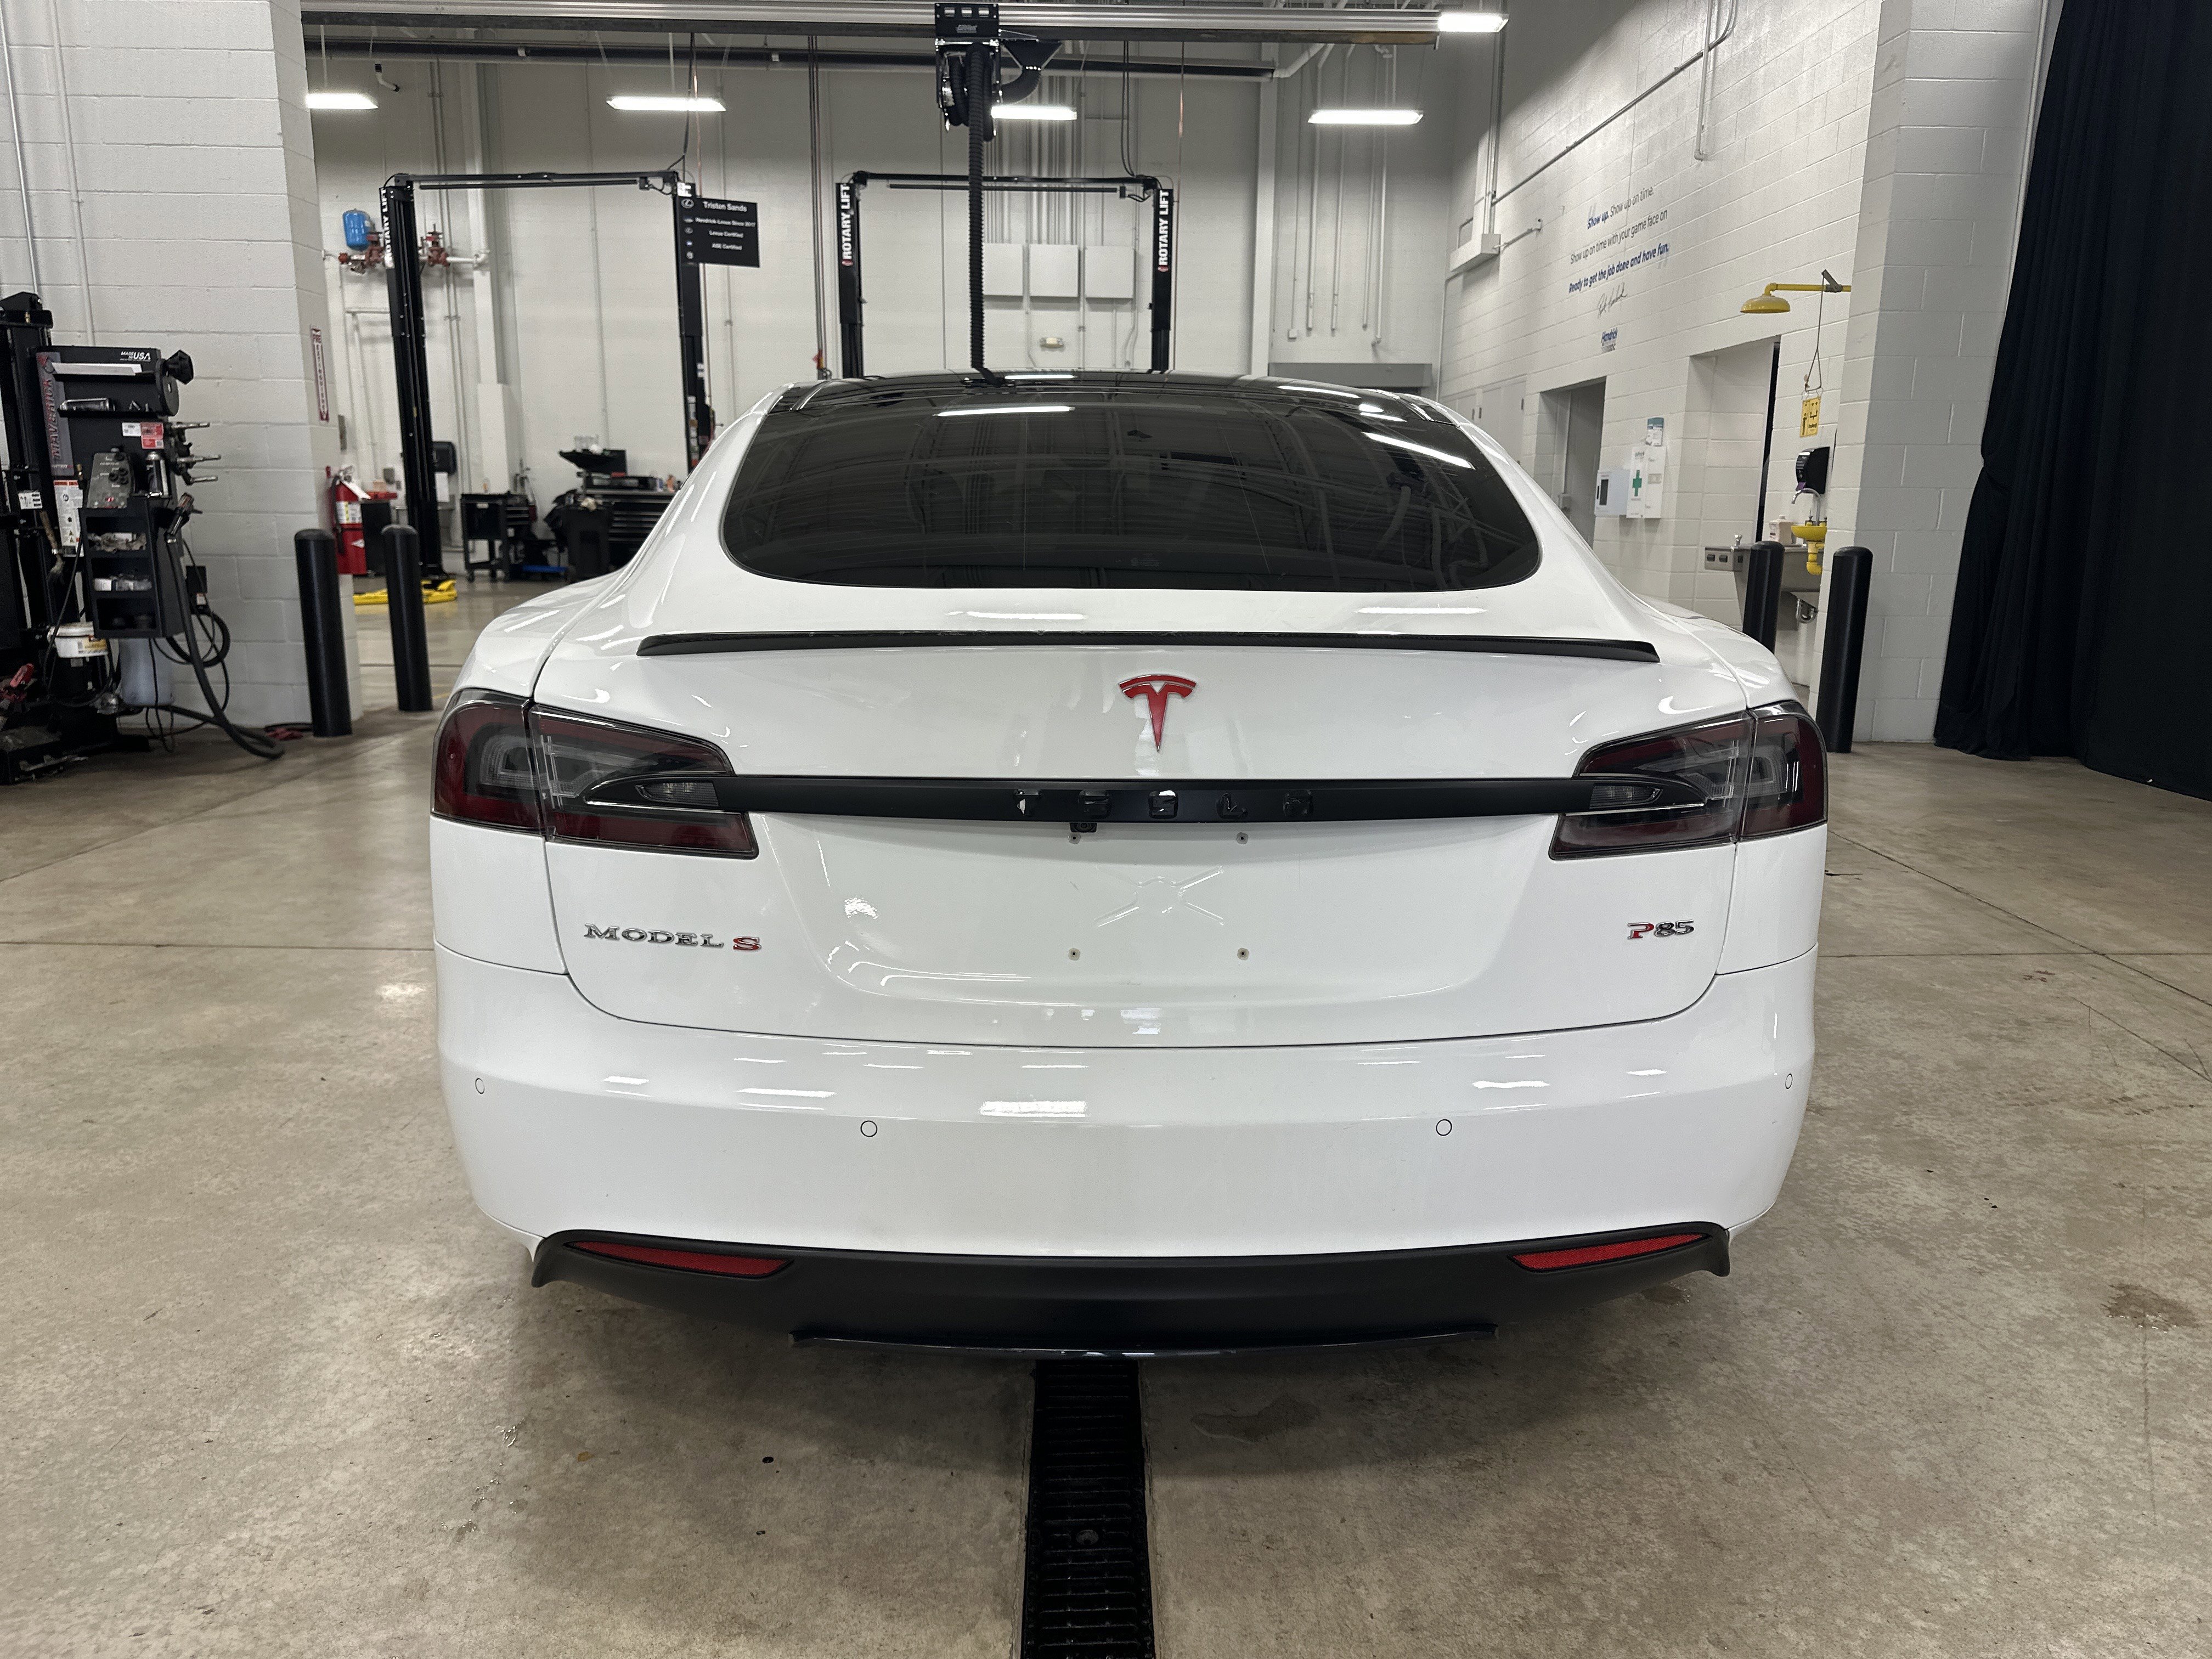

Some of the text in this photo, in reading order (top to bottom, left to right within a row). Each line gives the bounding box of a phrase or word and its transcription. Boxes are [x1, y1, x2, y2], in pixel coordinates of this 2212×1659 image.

[727, 203, 747, 212] Sands
[840, 184, 852, 259] ROTARY LIFT
[1159, 190, 1169, 266] ROTARY LIFT
[1587, 217, 1601, 229] Show
[1610, 204, 1623, 217] Show
[1624, 198, 1632, 209] up
[1632, 194, 1639, 205] on
[1640, 187, 1654, 201] time.
[1570, 210, 1668, 264] Show up on time with your game face on
[1569, 242, 1669, 293] Ready to get the job done and have fun.
[133, 352, 151, 360] USA
[584, 923, 762, 951] MODEL S
[1627, 919, 1695, 940] P85
